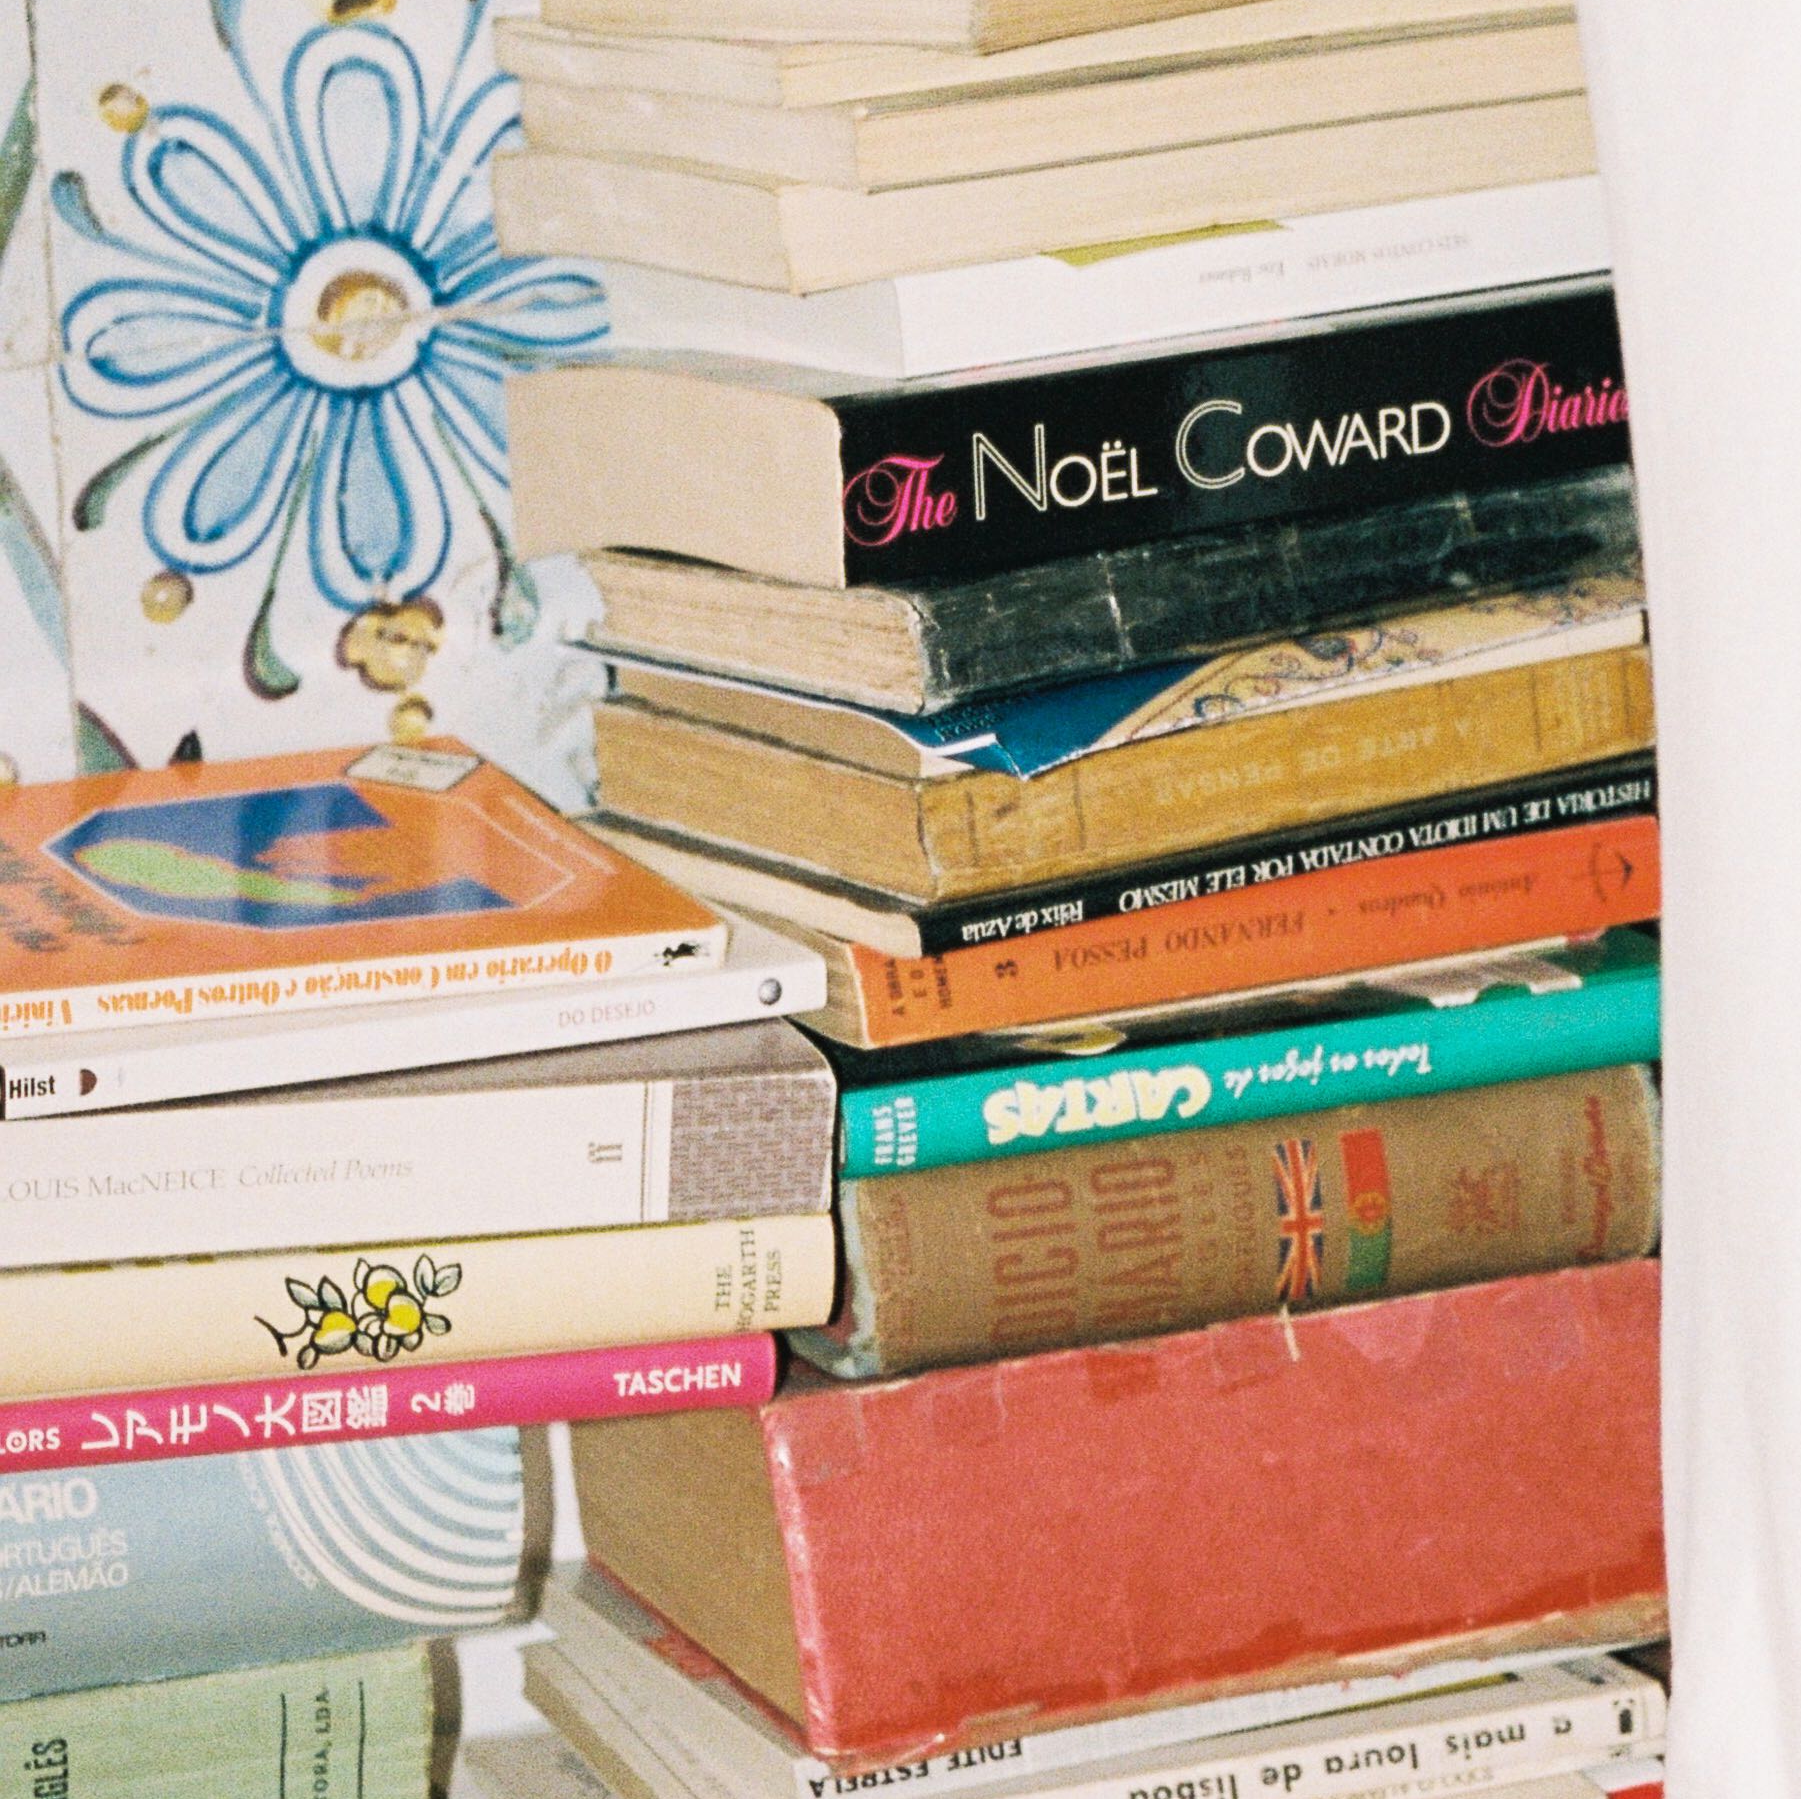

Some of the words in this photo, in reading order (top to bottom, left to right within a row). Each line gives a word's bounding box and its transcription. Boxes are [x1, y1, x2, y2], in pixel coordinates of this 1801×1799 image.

[843, 453, 957, 547] The
[971, 423, 1158, 521] NOËL
[1175, 398, 1450, 490] COWARD
[1481, 805, 1520, 836] UM
[1522, 797, 1552, 823] DE
[1408, 812, 1479, 847] IDIOTA
[1251, 850, 1295, 881] POR
[1299, 831, 1405, 870] CONTADA
[1119, 873, 1201, 913] MESMO
[1204, 866, 1246, 893] ELE
[1014, 909, 1039, 936] de
[1163, 908, 1306, 954] FERNANDO
[486, 947, 589, 988] Operário
[593, 950, 614, 977] O
[1051, 934, 1150, 974] PESSOA
[283, 977, 298, 1000] e
[305, 964, 441, 1001] Construção
[446, 961, 480, 986] em
[97, 987, 195, 1020] Poemas
[198, 979, 281, 1013] Outros
[1257, 1044, 1325, 1086] jogos
[1330, 1053, 1359, 1073] os
[1362, 1042, 1433, 1078] Todos
[8, 1074, 56, 1100] Hilst
[1222, 1067, 1254, 1101] de
[983, 1062, 1211, 1146] CARTAS
[0, 1176, 80, 1204] OUIS
[87, 1169, 226, 1198] MacNEICE
[237, 1158, 337, 1189] Collected
[342, 1156, 413, 1182] Poems
[714, 1264, 733, 1312] THE
[763, 1248, 782, 1313] PRESS
[613, 1361, 742, 1398] TASCHEN
[81, 1385, 389, 1453] レアモノ大図鑑
[1446, 1720, 1527, 1764] mais
[1553, 1716, 1574, 1739] a
[1261, 1755, 1304, 1790] de
[1326, 1737, 1420, 1778] loura
